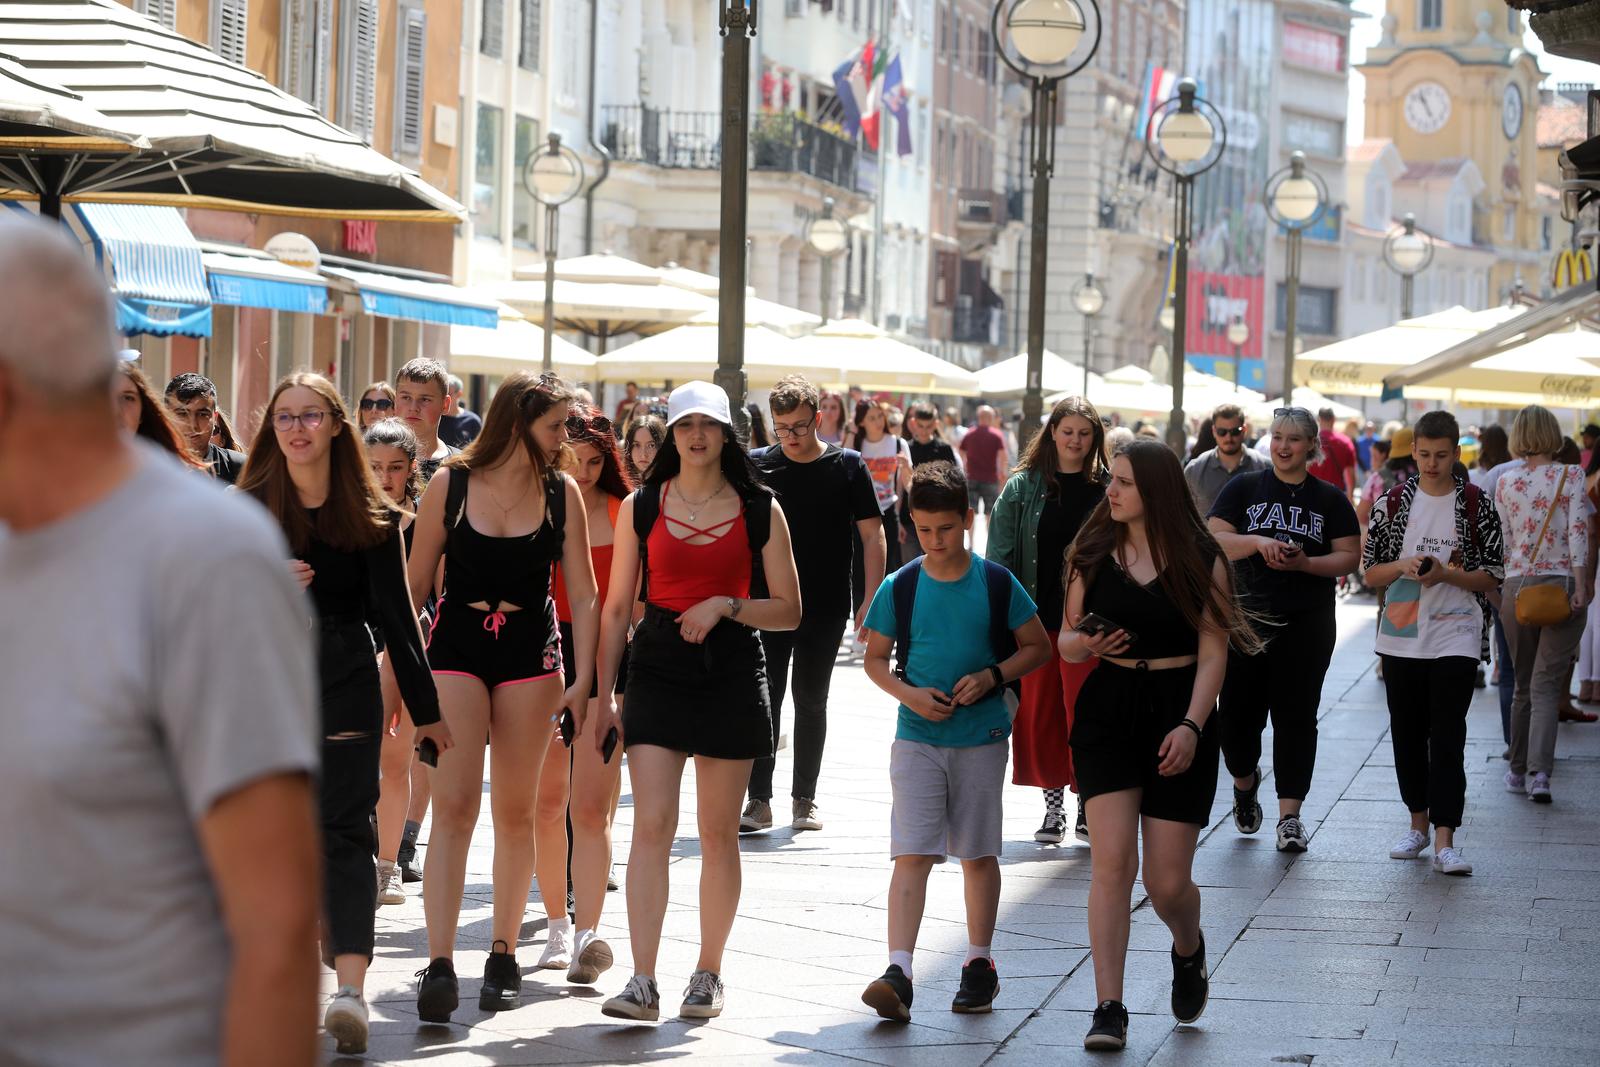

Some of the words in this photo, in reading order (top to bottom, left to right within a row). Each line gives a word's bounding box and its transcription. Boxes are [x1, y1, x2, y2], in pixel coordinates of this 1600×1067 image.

[1246, 502, 1324, 544] YALE
[1416, 544, 1427, 552] BE
[1422, 537, 1439, 545] THIS
[1440, 539, 1458, 548] MUS
